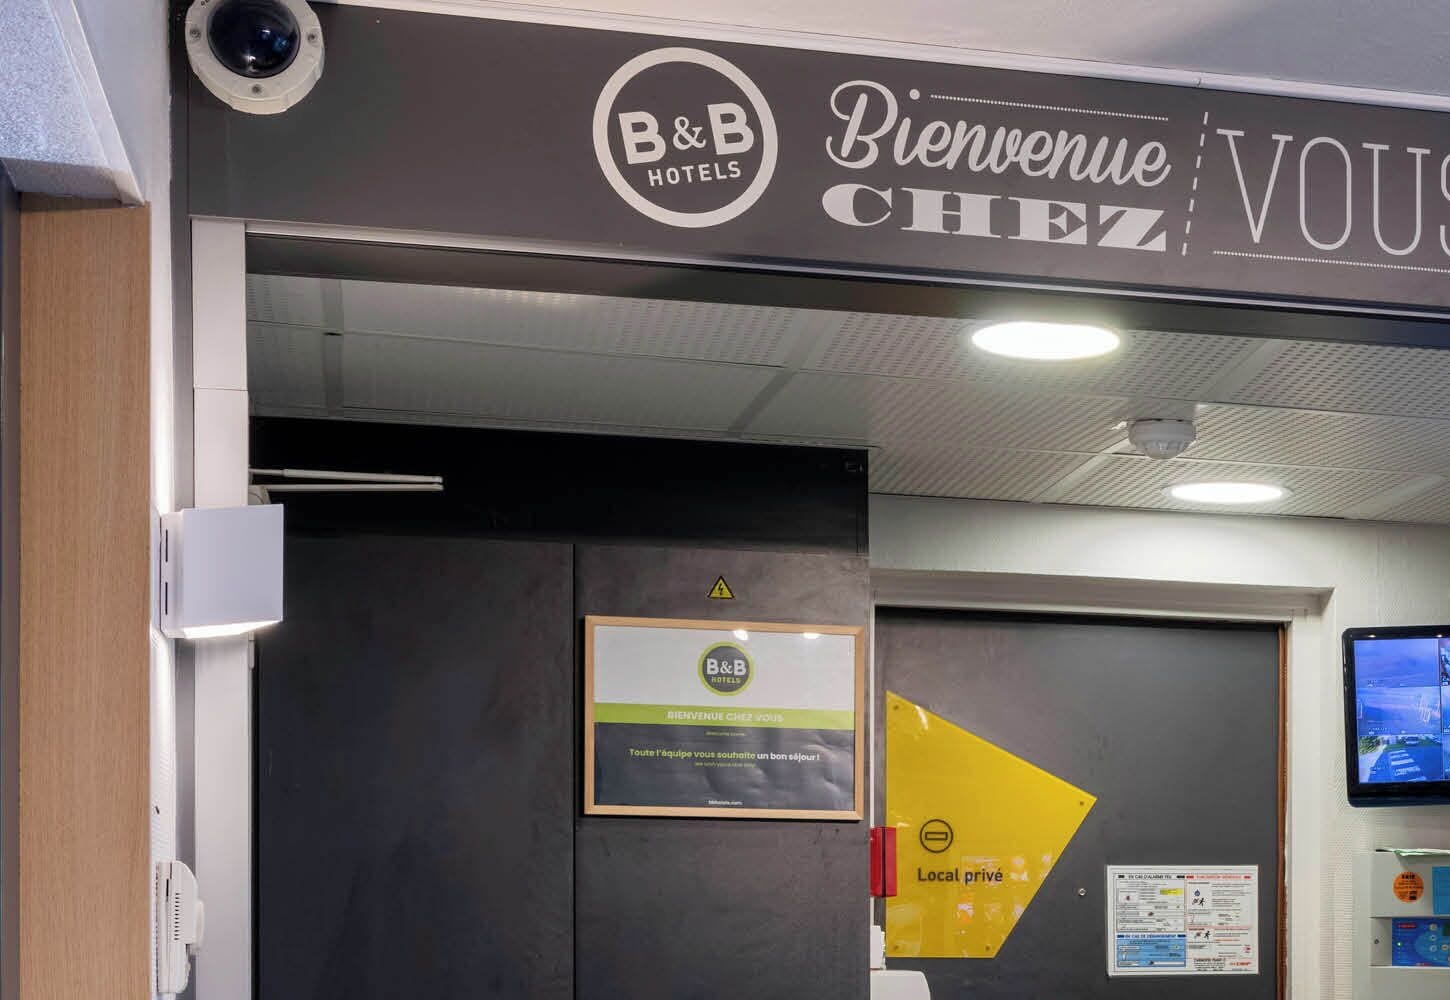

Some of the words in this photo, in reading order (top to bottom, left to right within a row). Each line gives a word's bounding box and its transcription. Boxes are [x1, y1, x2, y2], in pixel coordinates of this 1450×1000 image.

[619, 101, 756, 166] B&B
[826, 79, 1170, 187] Bienvenue
[647, 160, 742, 188] HOTELS
[822, 183, 1167, 253] CHEZ
[706, 658, 747, 676] B&B
[711, 676, 741, 684] HOTELS
[667, 711, 723, 720] BIENVENUE
[726, 712, 752, 721] CHEZ
[756, 714, 784, 722] VOUS
[630, 749, 654, 757] Toute
[656, 749, 692, 759] l'équipe
[770, 752, 787, 760] bon
[917, 867, 959, 883] Local
[963, 866, 1003, 887] privé
